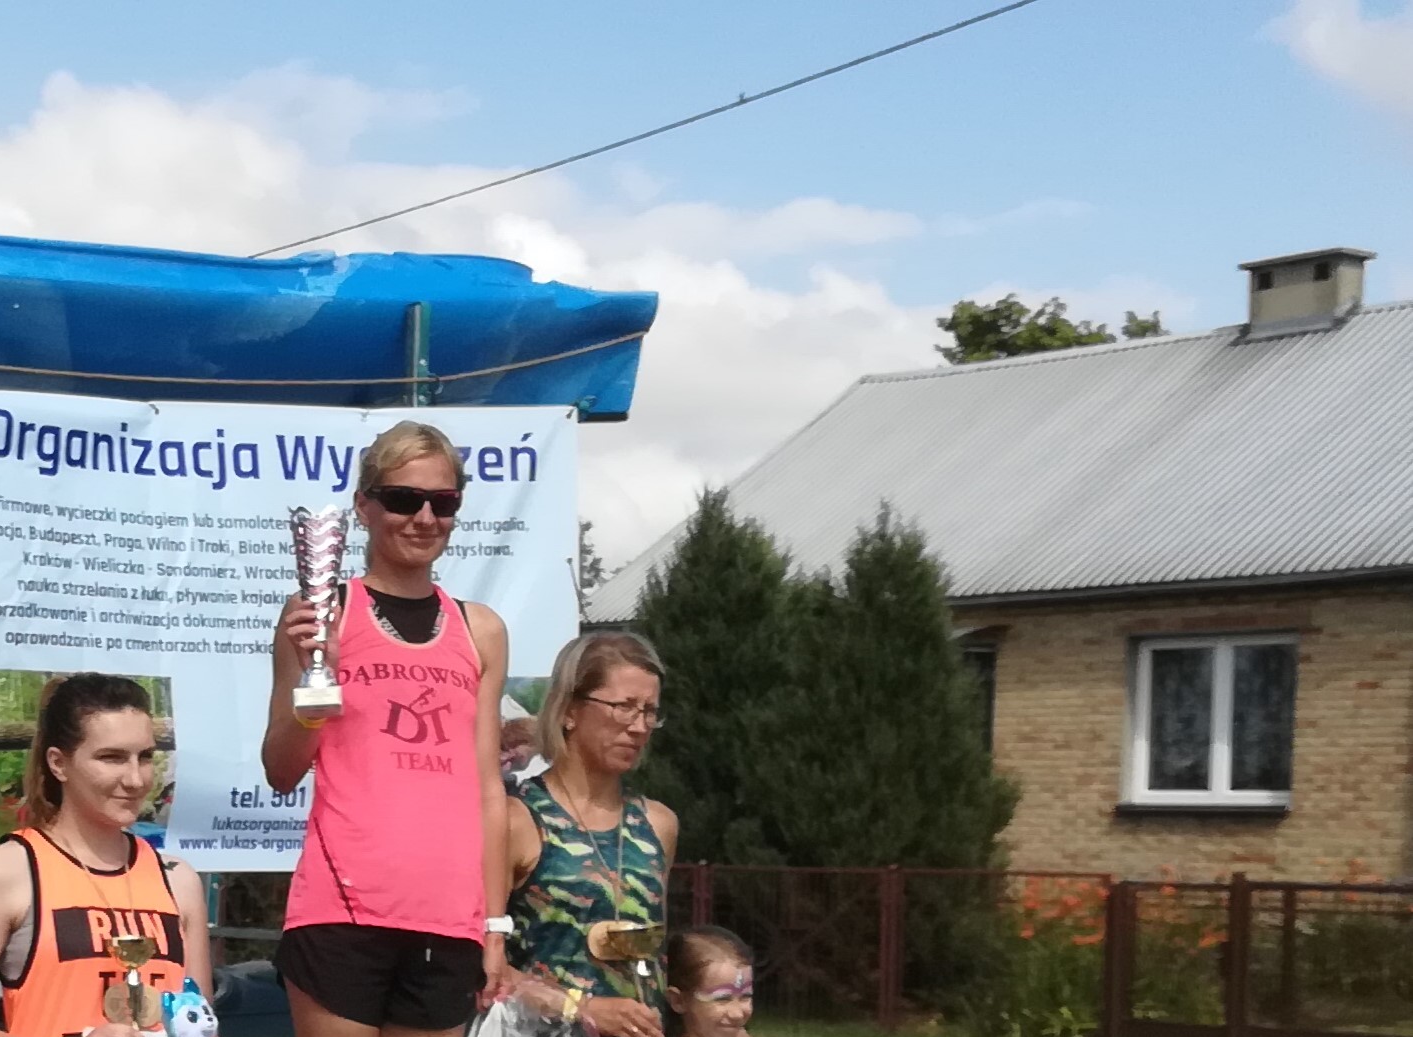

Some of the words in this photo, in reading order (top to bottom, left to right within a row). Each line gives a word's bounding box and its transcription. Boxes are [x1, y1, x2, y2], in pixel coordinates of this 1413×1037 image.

[276, 431, 538, 492] Wyzeń
[56, 503, 117, 522] wycieczki
[193, 512, 214, 529] lub
[29, 526, 101, 546] Budapeszt,
[147, 536, 186, 552] Wilno
[190, 537, 195, 552] i
[198, 538, 235, 557] Troki,
[239, 539, 275, 555] Białe
[22, 551, 73, 570] Kraków
[82, 556, 145, 576] Wieliczka
[156, 562, 242, 580] Sandomierz,
[17, 577, 60, 594] nauka
[62, 581, 128, 600] strzelania
[130, 588, 139, 600] z
[176, 587, 238, 606] pływanie
[91, 608, 96, 623] i
[99, 609, 180, 631] archiwizacja
[4, 631, 103, 650] oprowadzanie
[106, 636, 123, 651] po
[126, 637, 211, 654] cmentarzach
[214, 639, 275, 655] tatarskic
[390, 751, 454, 775] TEAM
[230, 785, 265, 809] tel.
[212, 816, 309, 834] lukasorganiza
[220, 835, 306, 853] lukas-organi
[87, 908, 169, 956] RUN
